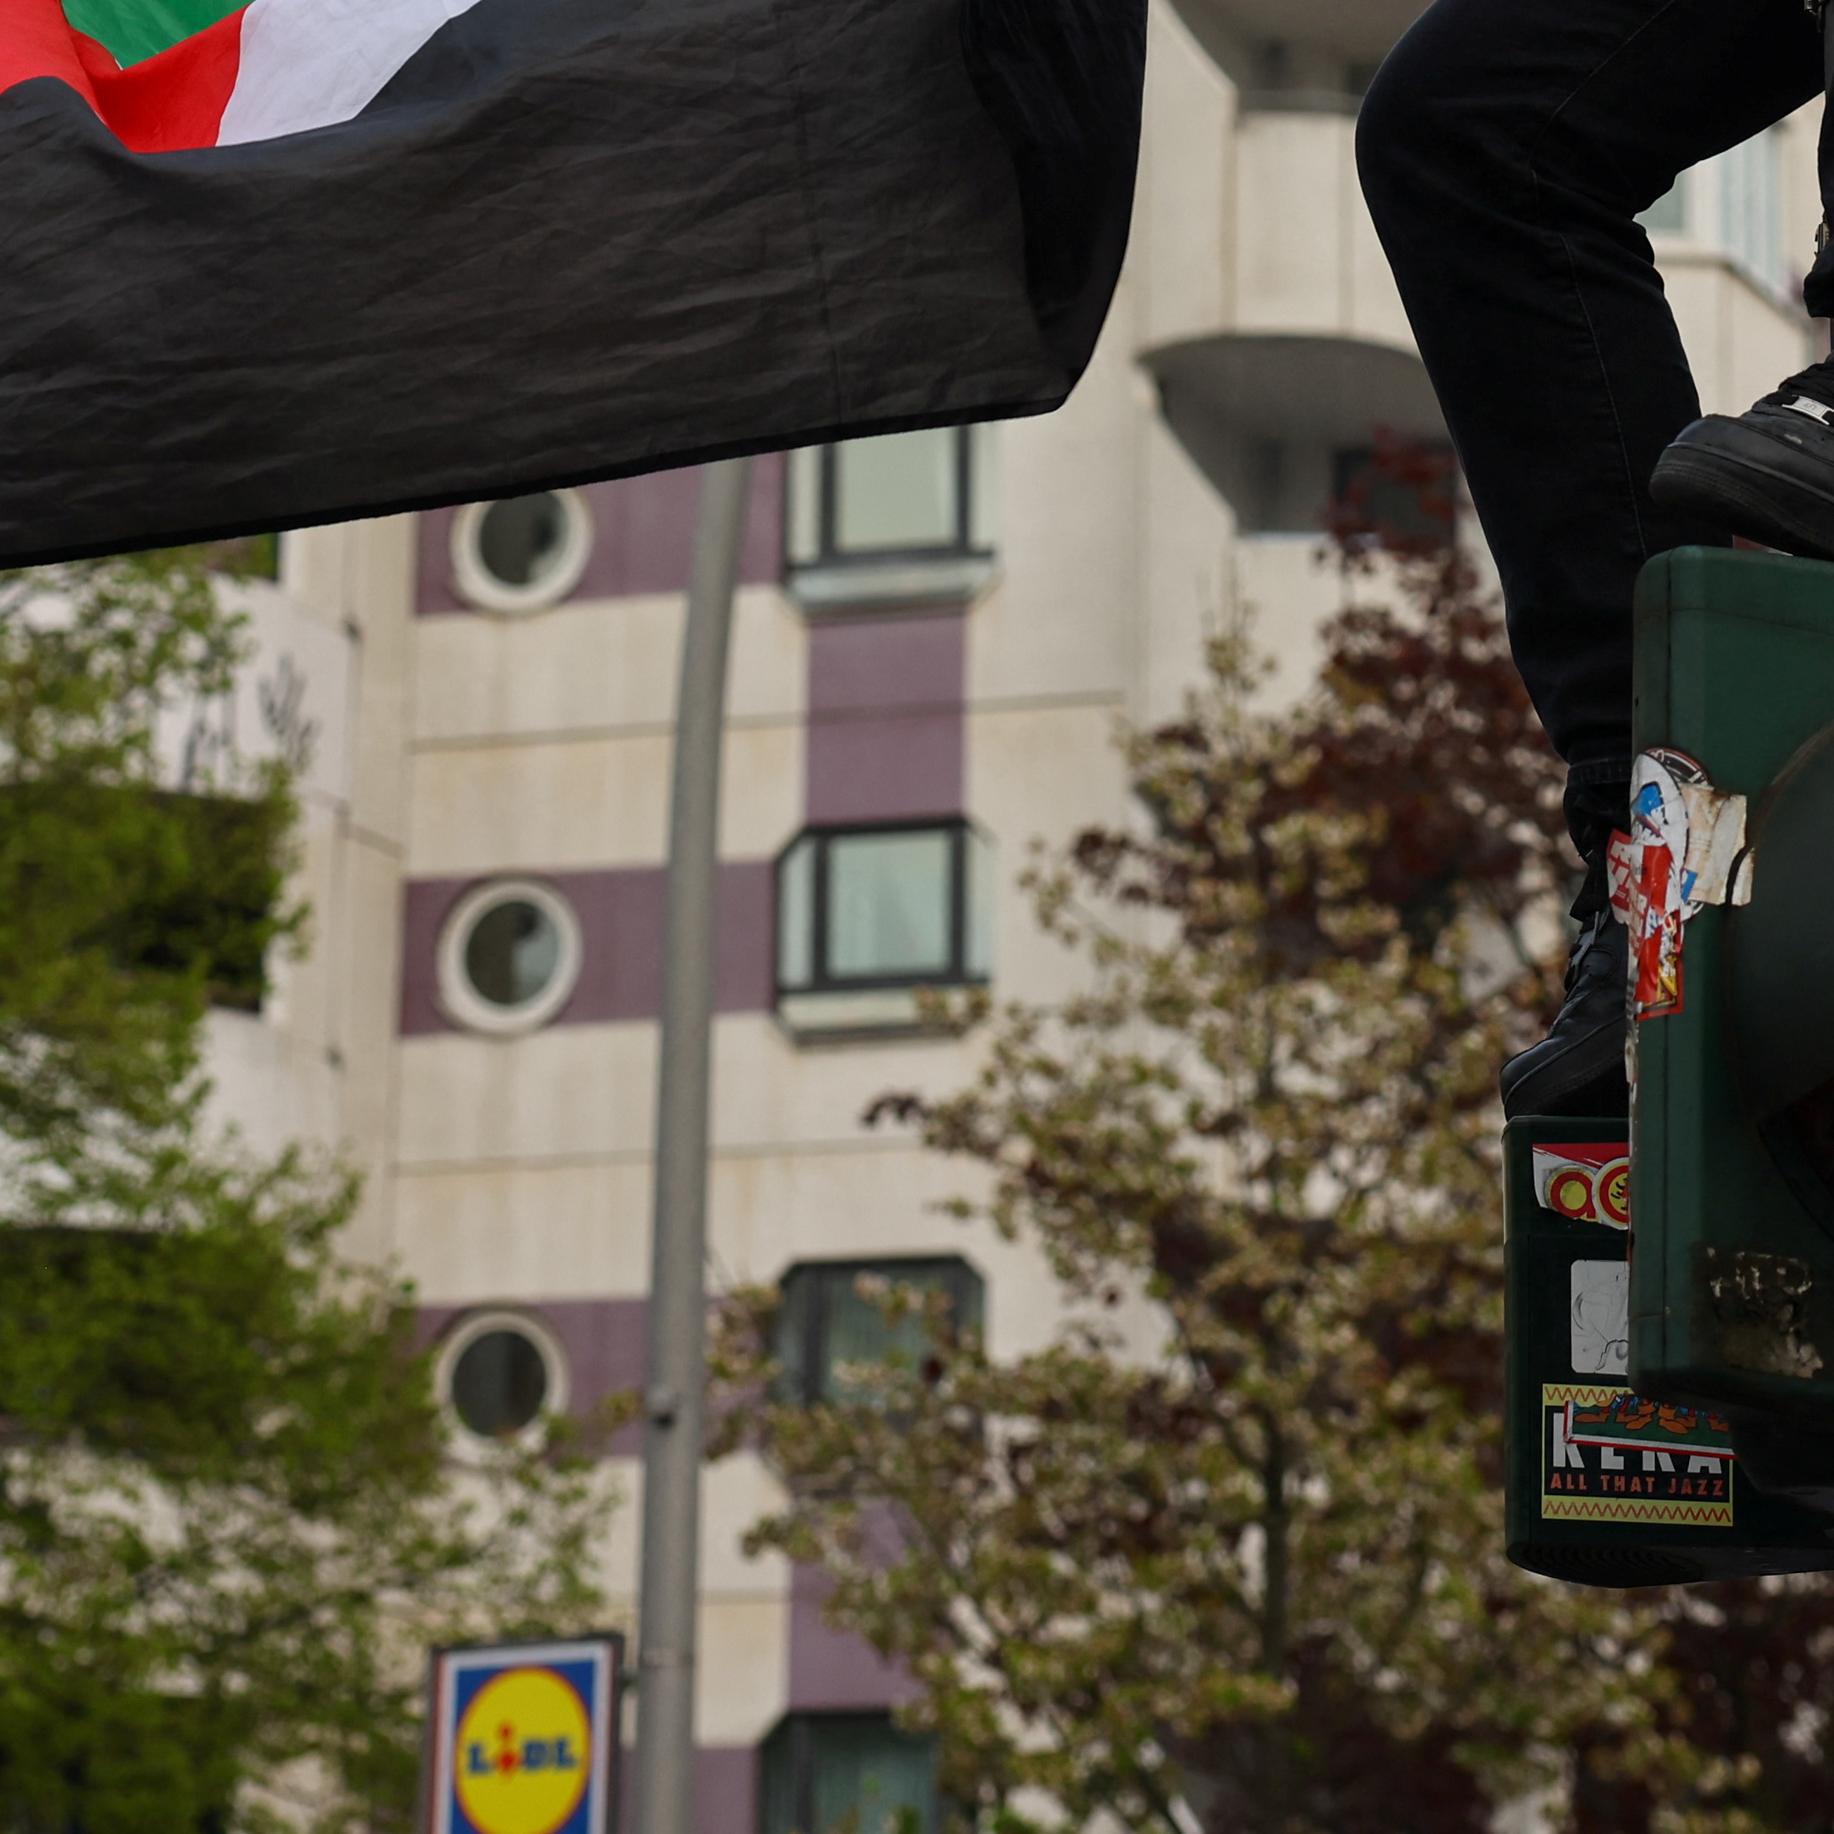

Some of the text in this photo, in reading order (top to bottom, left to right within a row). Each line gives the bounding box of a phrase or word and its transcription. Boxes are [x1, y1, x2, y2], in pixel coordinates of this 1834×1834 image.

[1550, 1472, 1725, 1496] ALL THAT JAZZ
